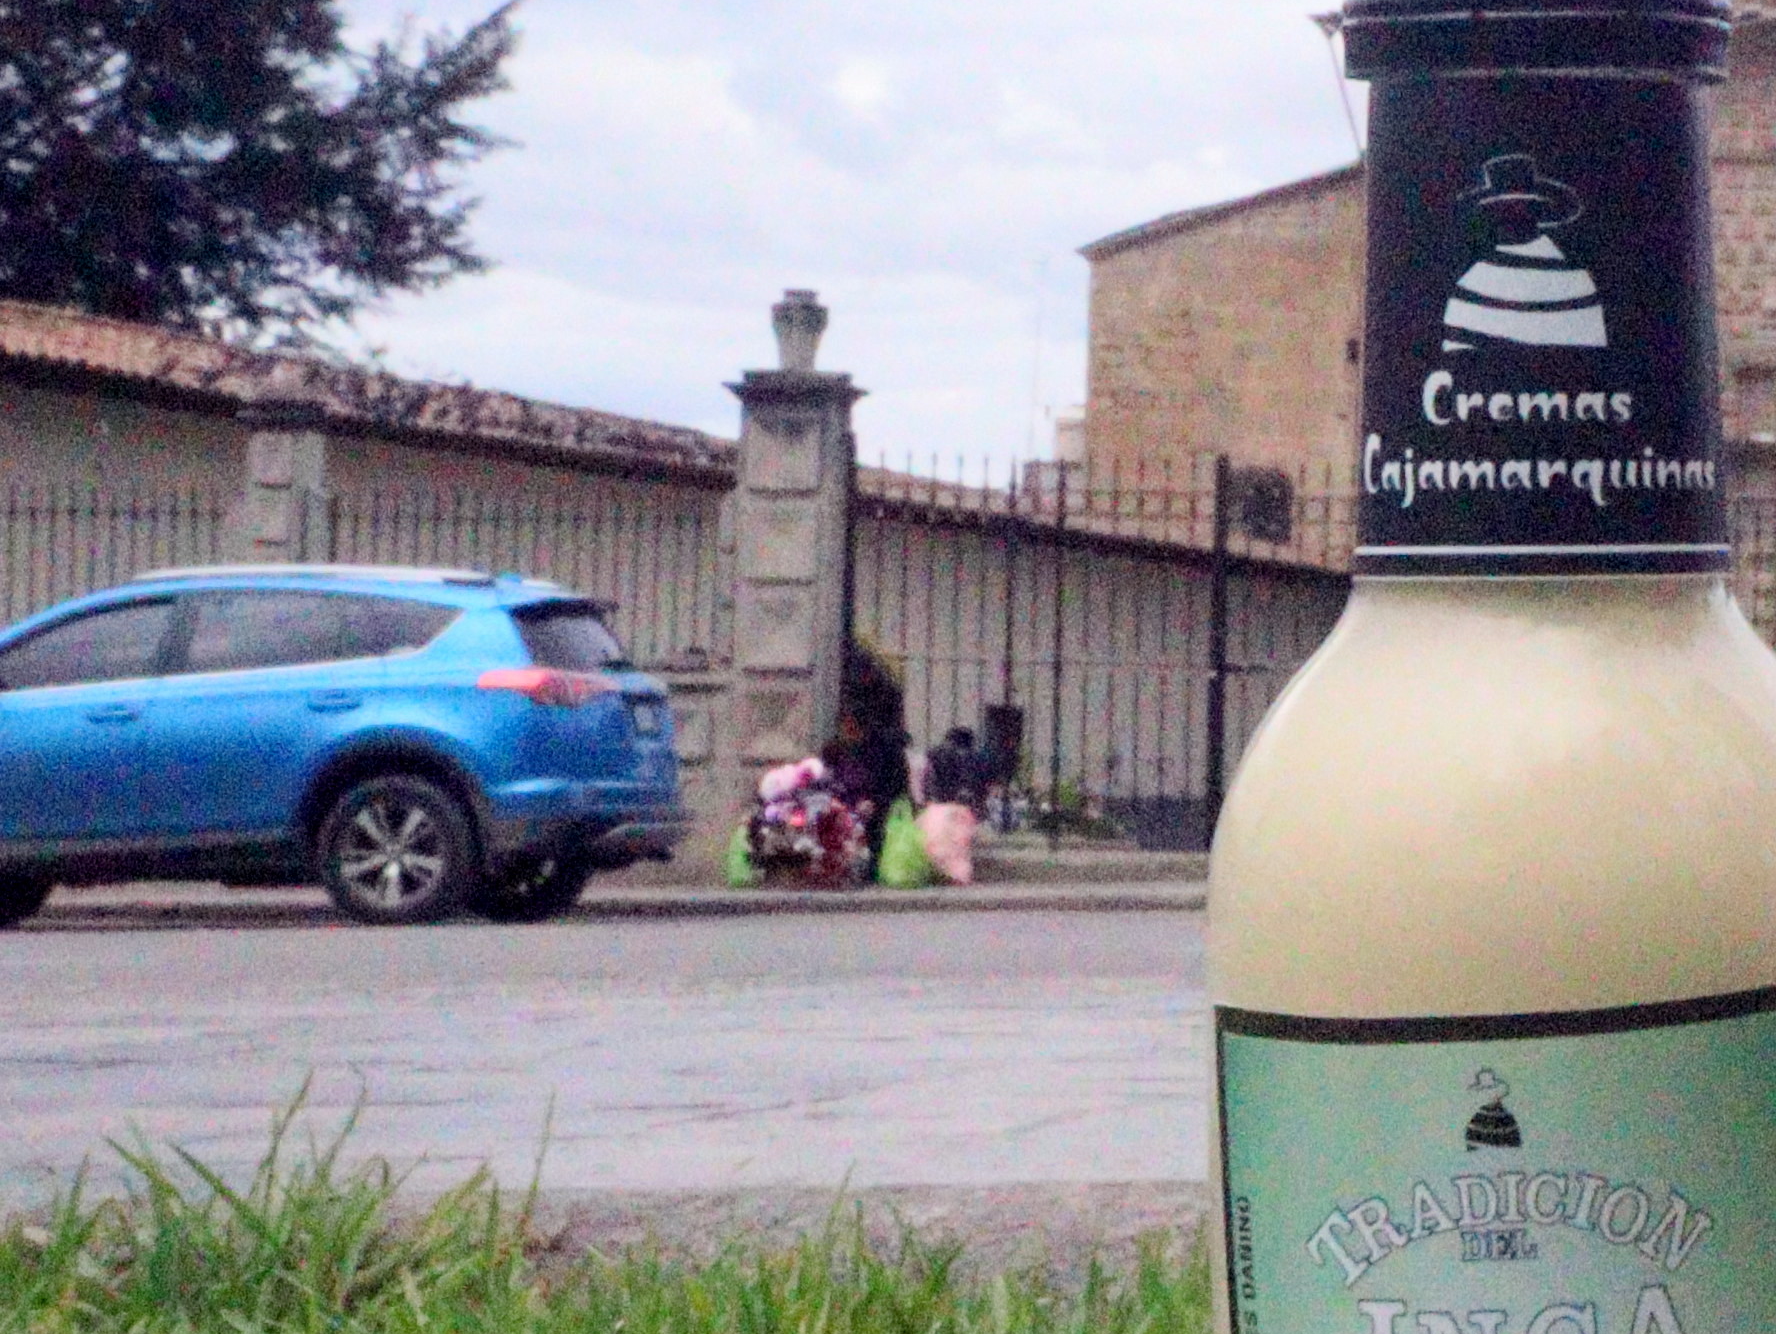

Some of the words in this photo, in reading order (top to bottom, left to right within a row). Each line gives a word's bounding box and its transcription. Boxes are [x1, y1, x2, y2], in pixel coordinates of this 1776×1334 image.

[1422, 369, 1632, 426] Cremas
[1305, 1170, 1711, 1288] TRADICION
[1461, 1227, 1540, 1262] DEL
